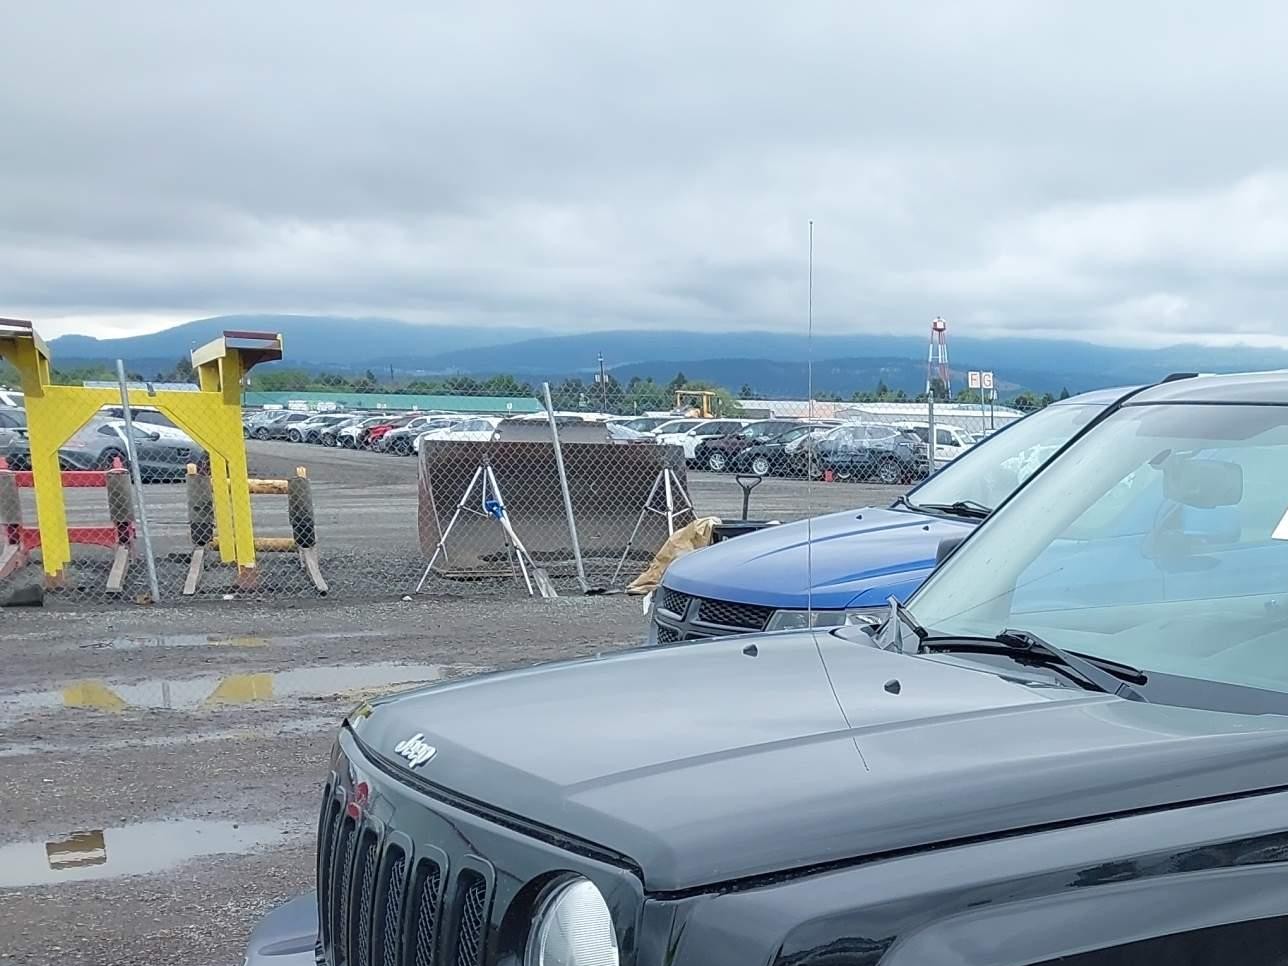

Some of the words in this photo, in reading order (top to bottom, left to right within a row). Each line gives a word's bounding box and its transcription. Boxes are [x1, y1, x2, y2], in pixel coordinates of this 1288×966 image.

[971, 374, 978, 386] F
[983, 374, 992, 387] G
[394, 733, 437, 769] Jeep
